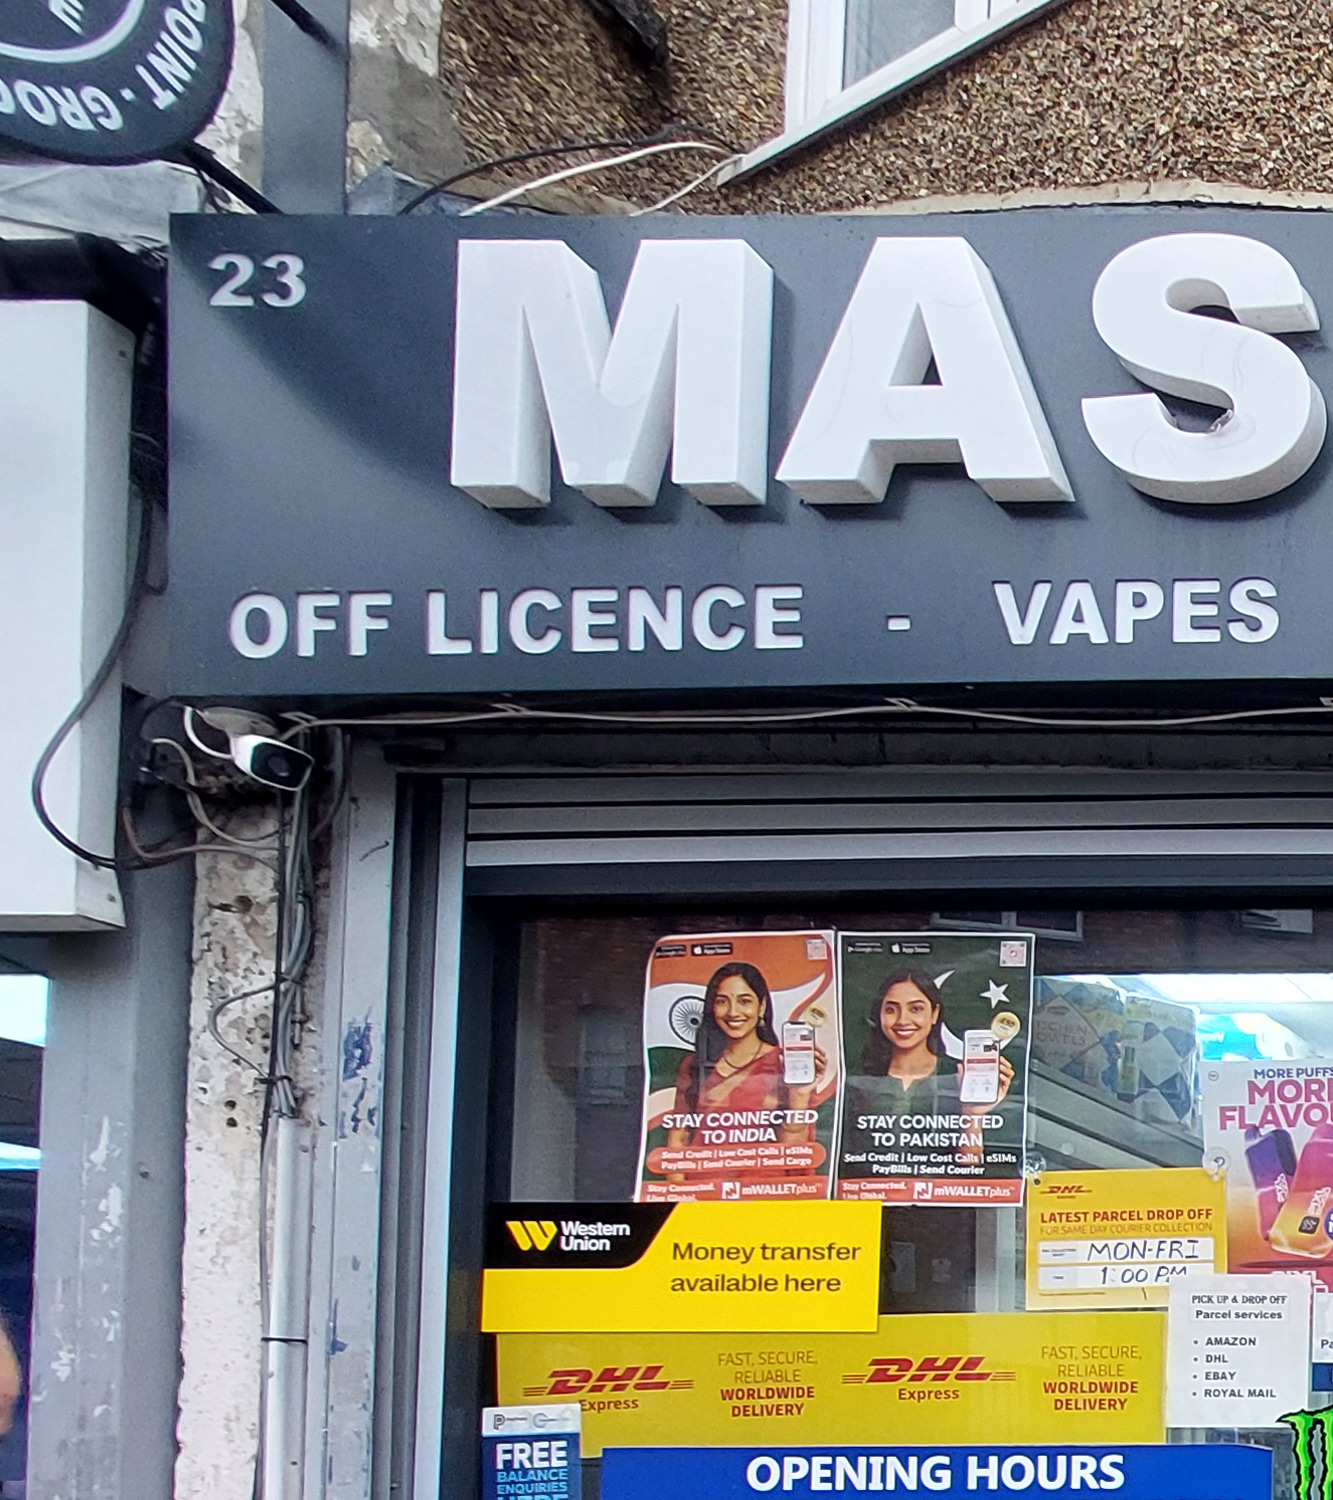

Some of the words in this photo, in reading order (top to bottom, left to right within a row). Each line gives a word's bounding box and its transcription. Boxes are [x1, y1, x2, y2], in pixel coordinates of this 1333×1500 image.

[210, 254, 305, 307] 23
[230, 593, 392, 659] OFF
[427, 586, 804, 655] LICENCE
[993, 579, 1280, 645] VAPES
[1254, 1067, 1293, 1079] MORE
[661, 1113, 702, 1129] STAY
[706, 1109, 819, 1127] CONNECTED
[856, 1115, 897, 1129] STAY
[900, 1115, 1004, 1129] CONNECTED
[701, 1129, 726, 1144] TO
[728, 1127, 777, 1143] INDIA
[872, 1133, 896, 1146] TO
[900, 1133, 984, 1147] PAKISTAN
[844, 1153, 867, 1163] Send
[868, 1153, 899, 1162] Credit
[907, 1153, 928, 1162] Low
[930, 1153, 952, 1162] Cost
[955, 1153, 979, 1163] Calls
[919, 1165, 944, 1174] Send
[946, 1165, 986, 1175] Courier
[1046, 1184, 1084, 1194] DHL
[1040, 1211, 1088, 1223] LATEST
[1092, 1210, 1143, 1222] PARCEL
[1147, 1209, 1184, 1221] DROP
[1188, 1208, 1213, 1220] OFF
[559, 1220, 631, 1238] Western
[1040, 1224, 1060, 1235] FOR
[1061, 1224, 1085, 1235] SAME
[1087, 1223, 1109, 1234] DAY
[1110, 1222, 1150, 1234] COURIER
[1152, 1221, 1213, 1233] COLLECTION
[559, 1235, 611, 1252] Union
[671, 1241, 755, 1265] Money
[760, 1241, 862, 1261] transfer
[670, 1273, 778, 1293] available
[783, 1273, 842, 1293] here
[1191, 1294, 1215, 1304] PICK
[1217, 1294, 1230, 1304] UP
[1241, 1294, 1267, 1304] DROP
[1269, 1293, 1287, 1304] OFF
[1195, 1309, 1232, 1320] Parcel
[1234, 1309, 1283, 1320] services
[1204, 1336, 1257, 1346] AMAZON
[718, 1352, 755, 1367] FAST,
[758, 1350, 818, 1366] SECURE,
[1040, 1346, 1079, 1362] FAST,
[1081, 1345, 1143, 1361] SECURE,
[1204, 1353, 1229, 1364] DHL
[734, 1368, 802, 1384] RELIABLE
[865, 1356, 992, 1383] DHL
[1057, 1363, 1124, 1379] RELIABLE
[1204, 1371, 1237, 1381] EBAY
[546, 1364, 672, 1396] DHL
[1042, 1380, 1139, 1395] WORLDWIDE
[719, 1385, 815, 1401] WORLDWIDE
[897, 1387, 960, 1404] Express
[1203, 1388, 1244, 1399] ROYAL
[1247, 1388, 1277, 1398] MAIL
[730, 1403, 804, 1418] DELIVERY
[1052, 1397, 1128, 1412] DELIVERY
[496, 1440, 568, 1470] FREE
[497, 1468, 568, 1483] BALANCE
[746, 1455, 954, 1492] OPENING
[967, 1455, 1125, 1492] HOURS
[497, 1481, 568, 1495] ENQUIRIES
